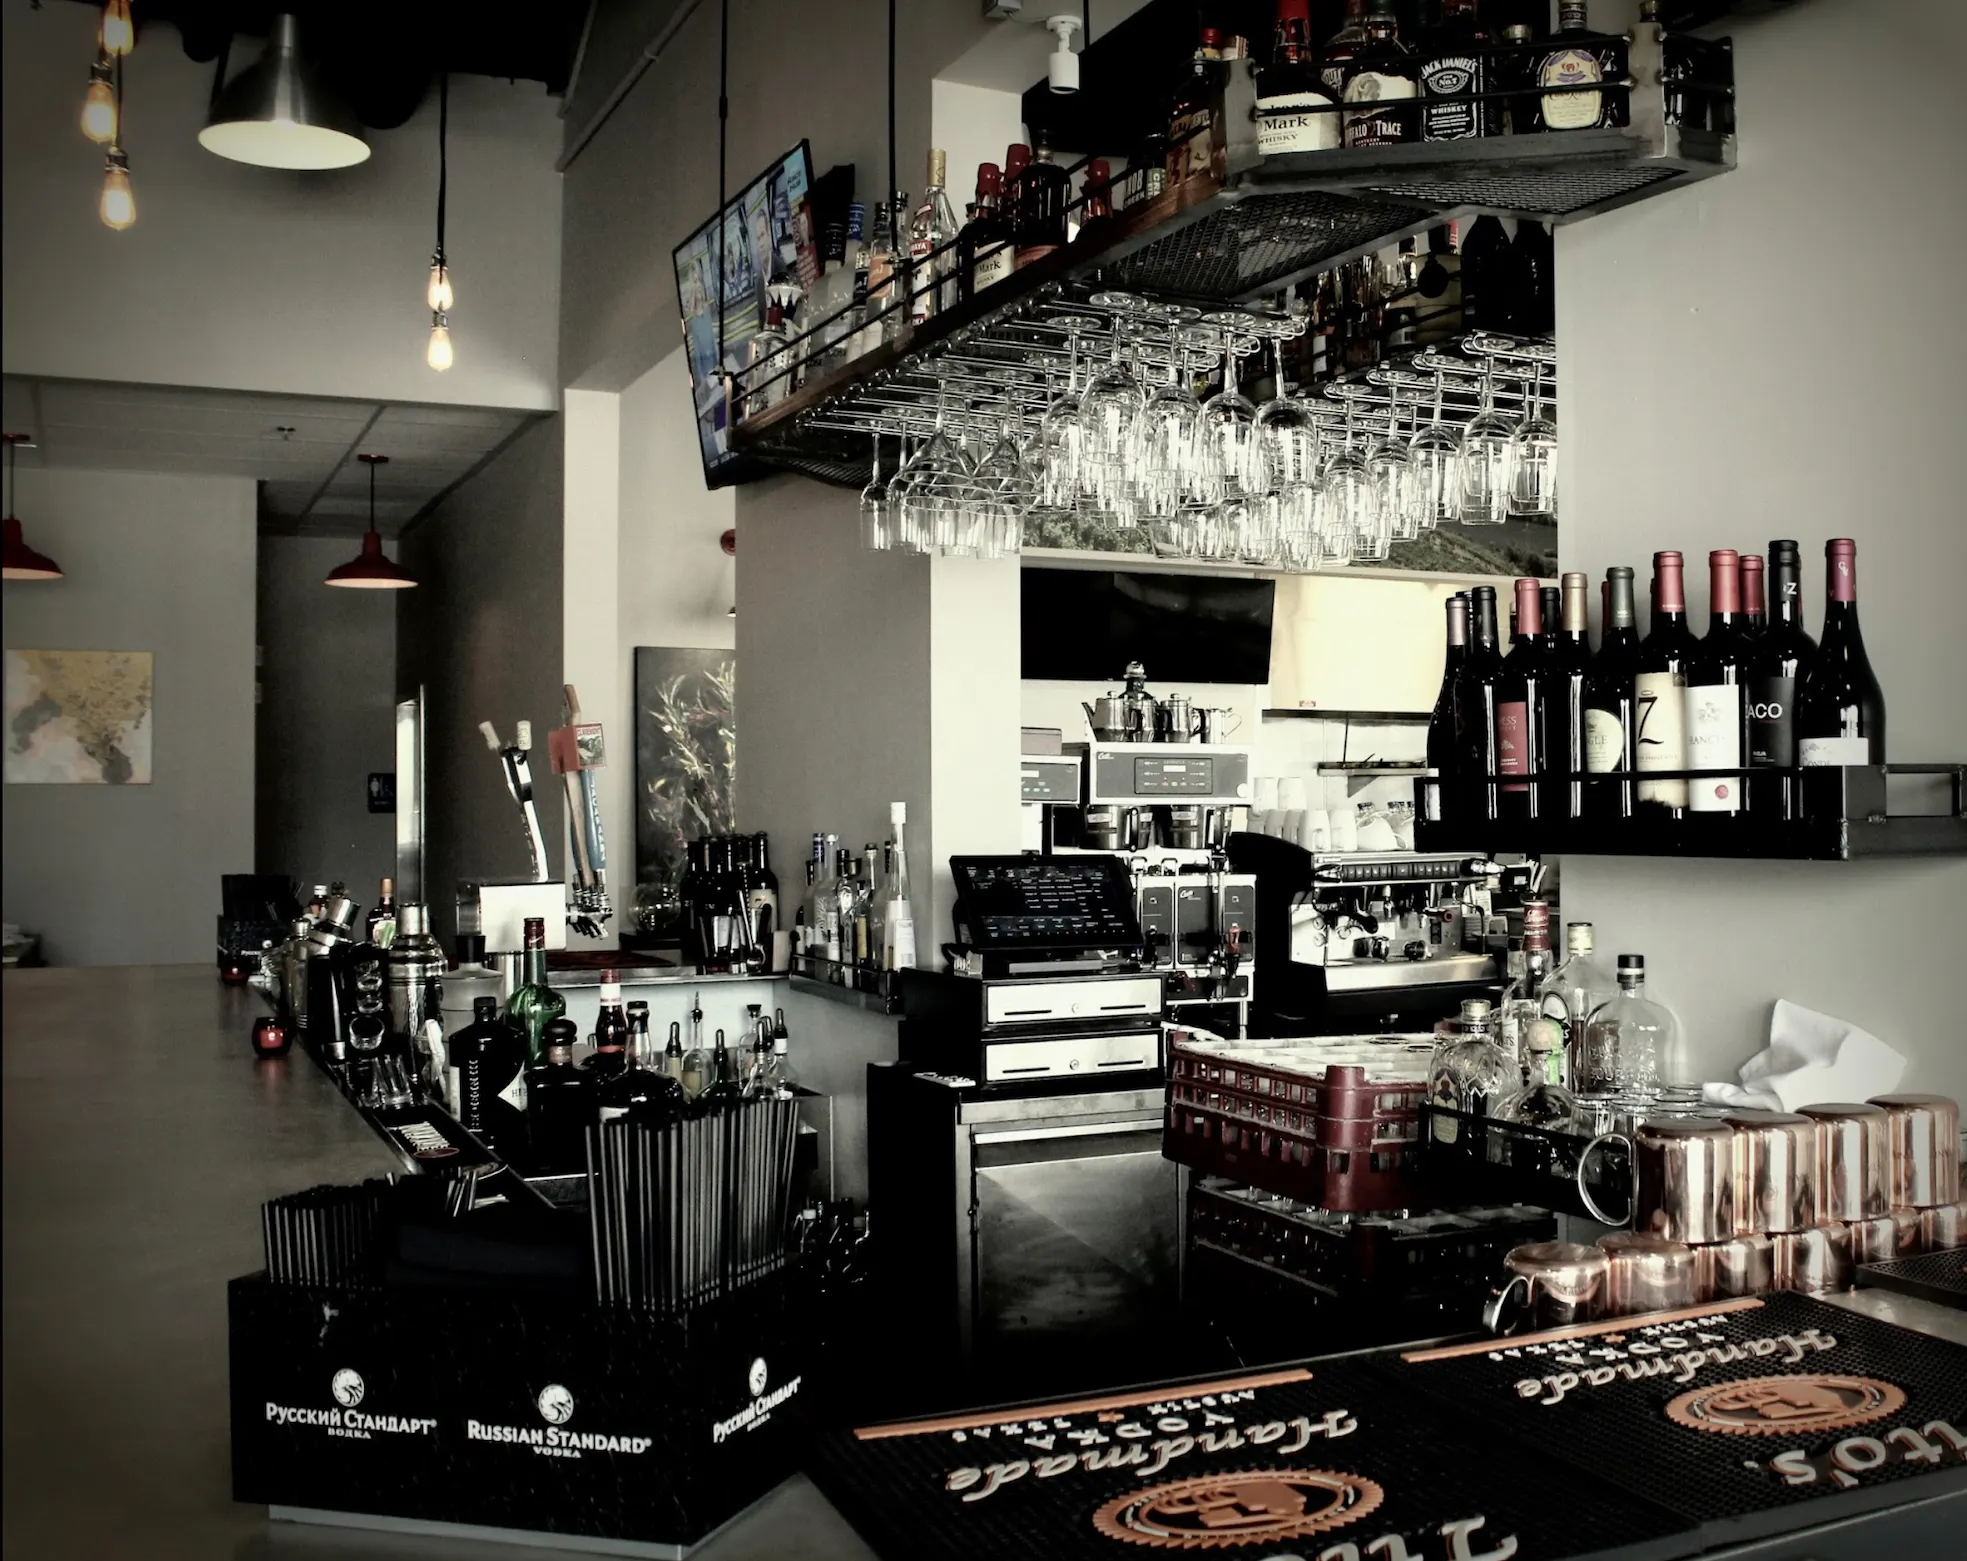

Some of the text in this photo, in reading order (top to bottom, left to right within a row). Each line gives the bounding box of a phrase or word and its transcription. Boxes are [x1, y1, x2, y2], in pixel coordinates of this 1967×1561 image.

[1421, 57, 1478, 80] JACK DANIEL'S
[1431, 104, 1467, 115] WHISKEY
[1264, 116, 1310, 132] Mark
[1376, 120, 1402, 136] TRACE
[1258, 134, 1298, 144] WHISKY
[980, 261, 1002, 274] Mark
[1554, 1331, 1725, 1365] VODKA
[1512, 1328, 1837, 1407] Handmade
[327, 1427, 372, 1439] ВОДКА
[467, 1419, 544, 1445] RUSSIAN
[1023, 1409, 1235, 1452] VODKA
[532, 1446, 582, 1458] VODKA
[944, 1408, 1358, 1503] Handmade
[1769, 1419, 1967, 1488] ito's
